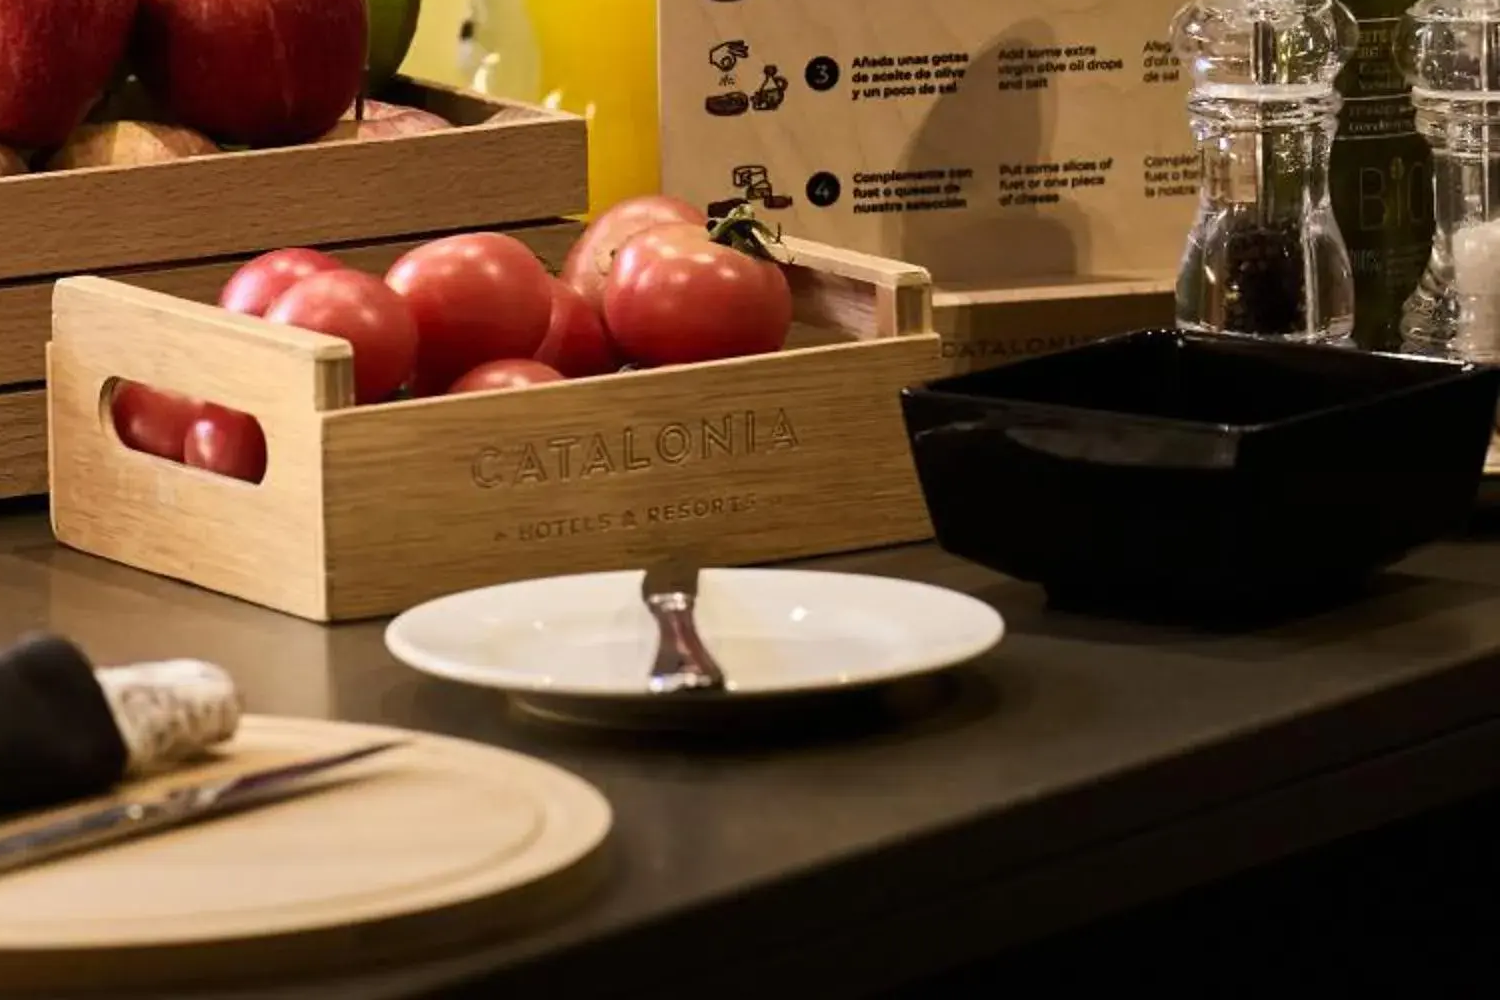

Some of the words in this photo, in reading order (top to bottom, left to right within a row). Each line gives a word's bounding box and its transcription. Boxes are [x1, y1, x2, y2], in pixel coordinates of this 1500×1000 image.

[470, 407, 799, 489] CATALONIA
[518, 512, 611, 542] HOTELS
[647, 492, 757, 522] RESORTS
